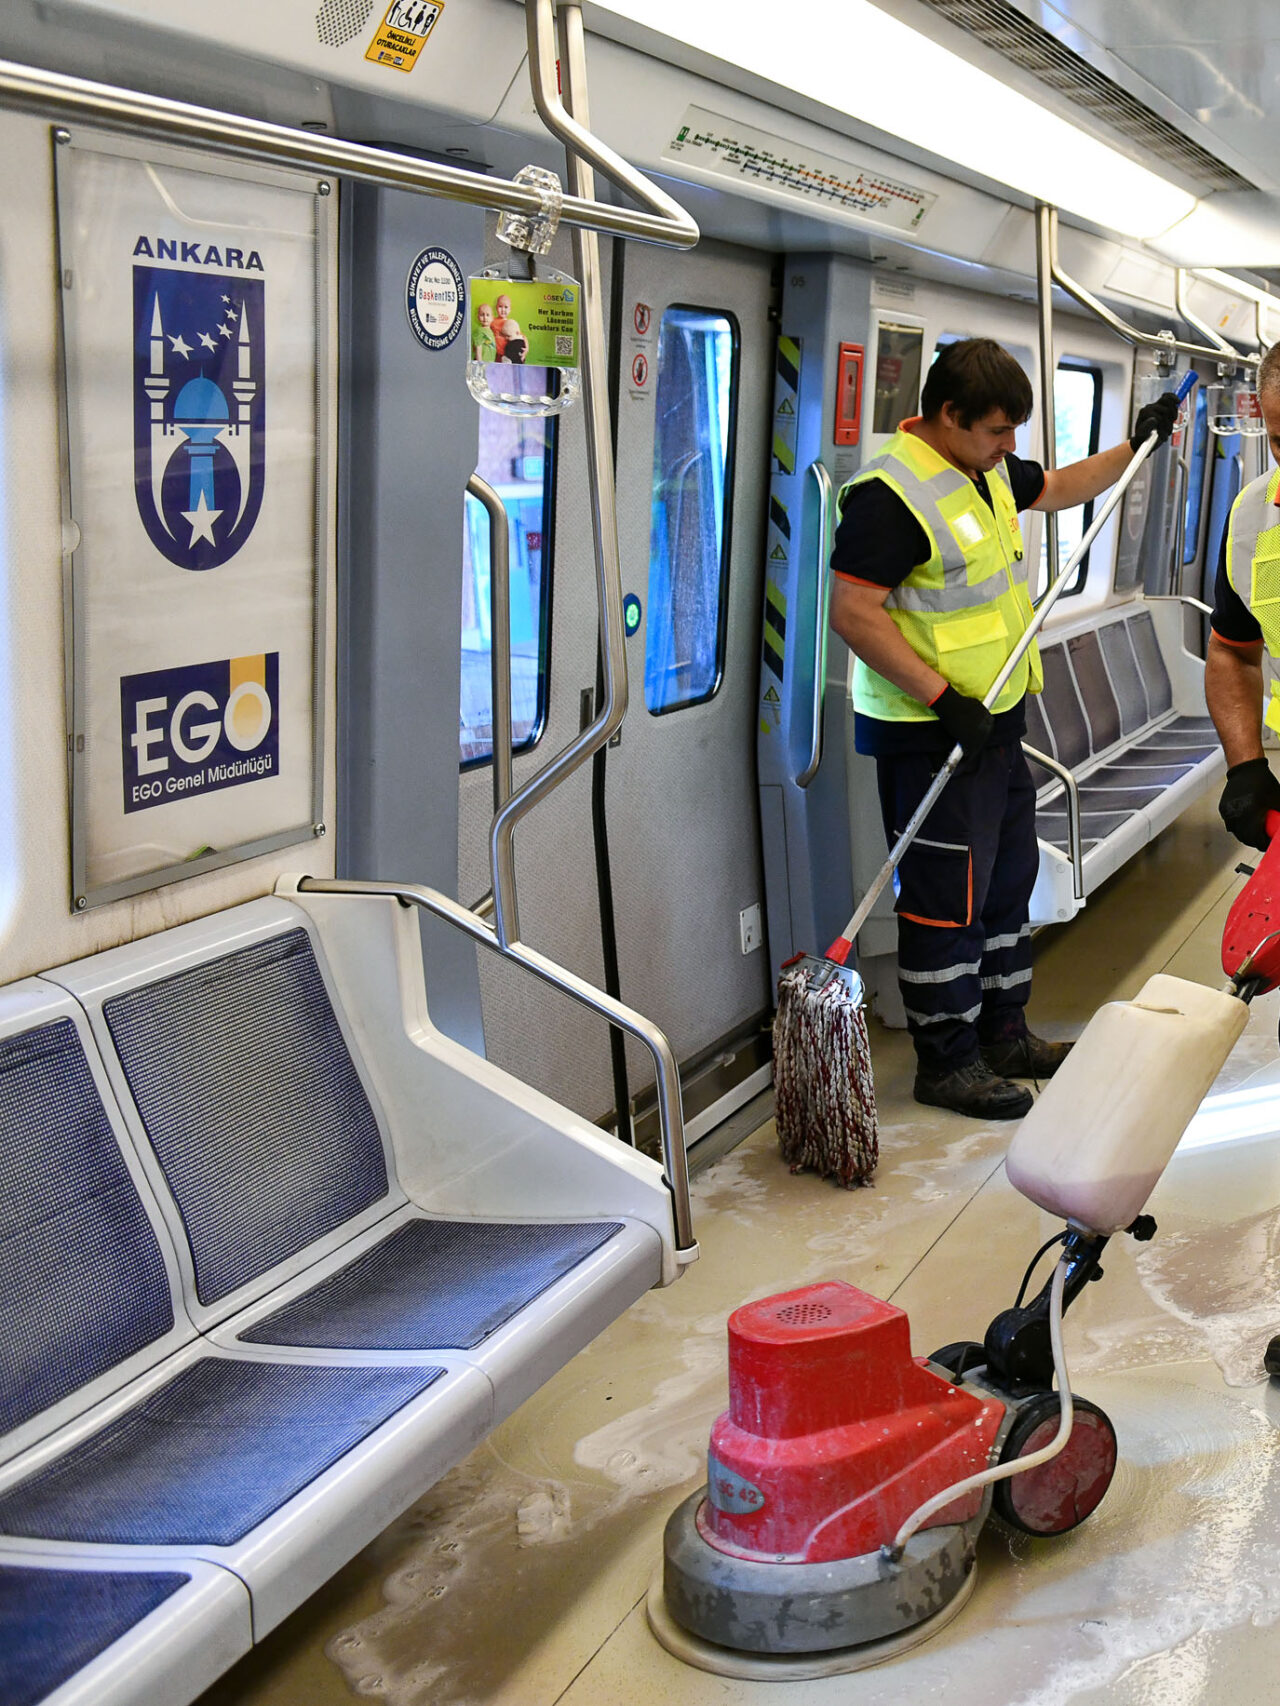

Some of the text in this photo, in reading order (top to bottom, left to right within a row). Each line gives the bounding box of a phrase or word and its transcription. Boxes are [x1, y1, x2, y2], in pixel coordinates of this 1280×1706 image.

[376, 38, 417, 57] OTURACAKLAR
[133, 235, 264, 271] ANKARA
[538, 308, 574, 317] Her Kurban
[131, 681, 272, 777] EGO
[132, 754, 273, 803] EGO Genel Müdürlüğü
[739, 1487, 758, 1505] 42
